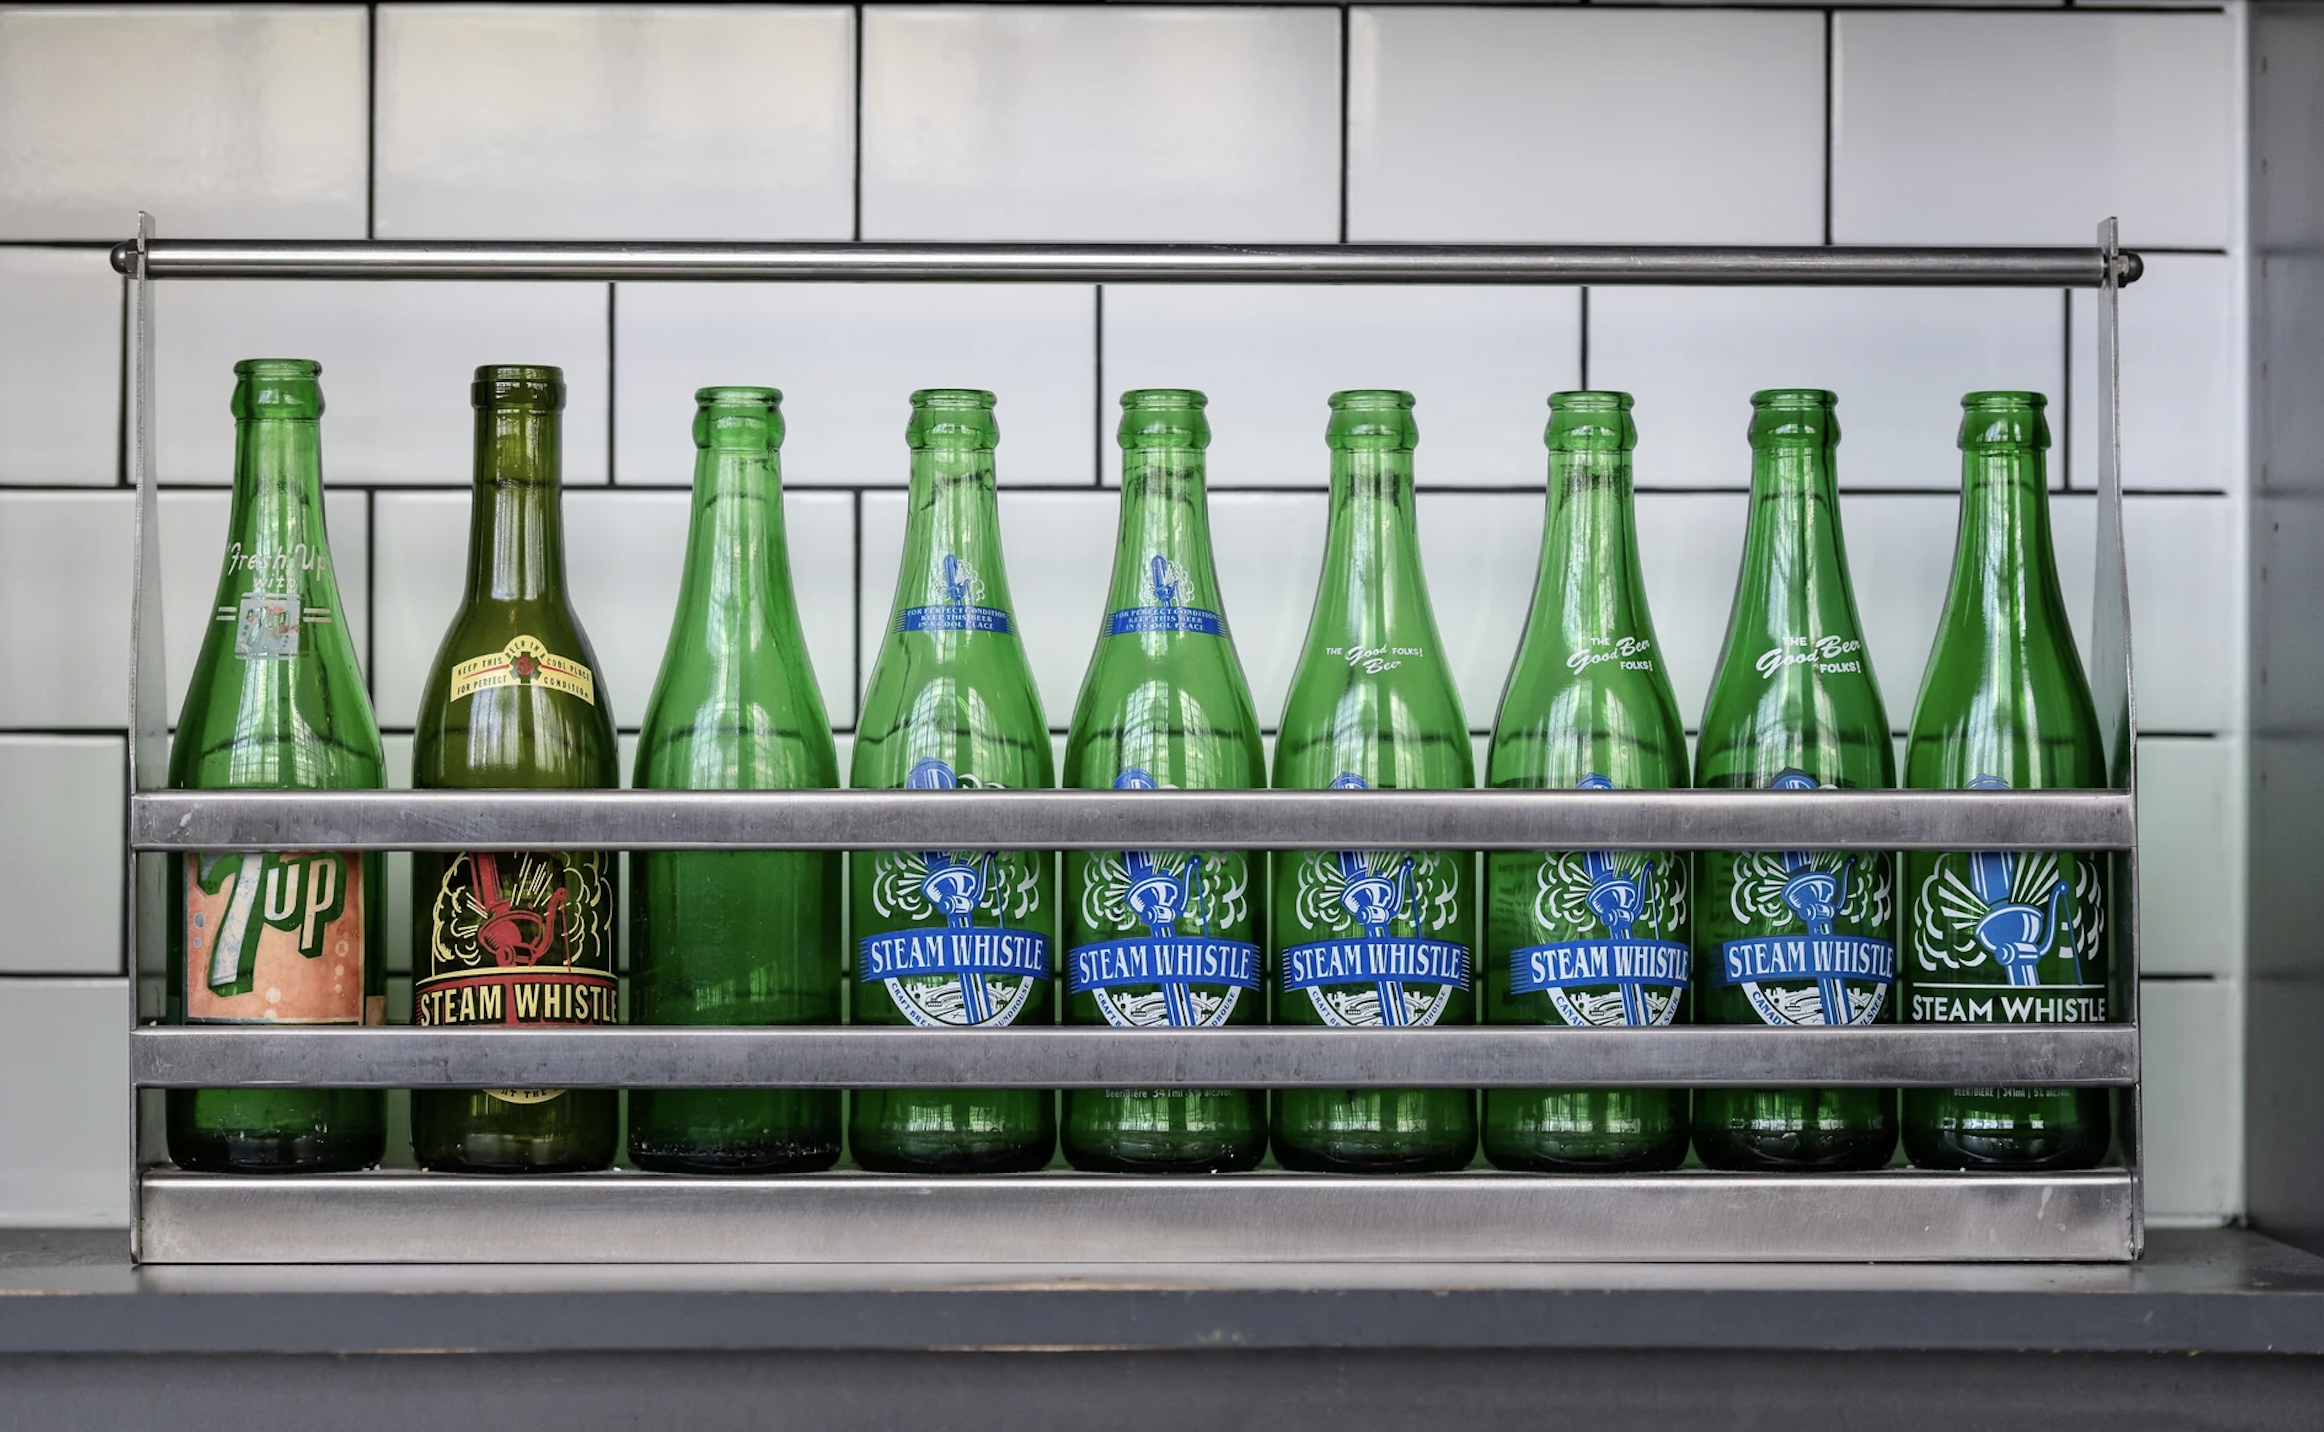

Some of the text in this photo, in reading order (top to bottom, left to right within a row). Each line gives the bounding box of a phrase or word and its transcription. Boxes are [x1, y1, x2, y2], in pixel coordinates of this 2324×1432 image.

[1325, 644, 1423, 667] THE Good FOLKS!
[1590, 637, 1611, 646] THE
[1782, 636, 1808, 647] THE
[458, 663, 479, 676] KEEP
[482, 656, 503, 668] THIS
[504, 640, 526, 660] BEER
[530, 640, 541, 652] IN
[546, 659, 567, 671] COOL
[570, 665, 590, 682] PLACE
[1362, 657, 1403, 674] Beer
[1566, 648, 1620, 676] Good
[1619, 660, 1654, 672] FOLKS!
[1755, 647, 1819, 680] Good
[1819, 660, 1862, 674] FOLKS!
[457, 675, 589, 698] FOR PERFECT CONDITION
[870, 934, 1044, 973] STEAM WHISTLE
[1078, 944, 1251, 984] STEAM WHISTLE
[1292, 944, 1461, 982] STEAM WHISTLE
[1530, 946, 1689, 984] STEAM WHISTLE
[1728, 941, 1894, 979] STEAM WHISTLE
[420, 981, 618, 1027] STEAM WHISTLE
[891, 982, 911, 1010] CRAFT
[1097, 993, 1116, 1020] CRAFT
[1311, 990, 1330, 1017] CRAFT
[1911, 994, 2106, 1023] STEAM WHISTLE
